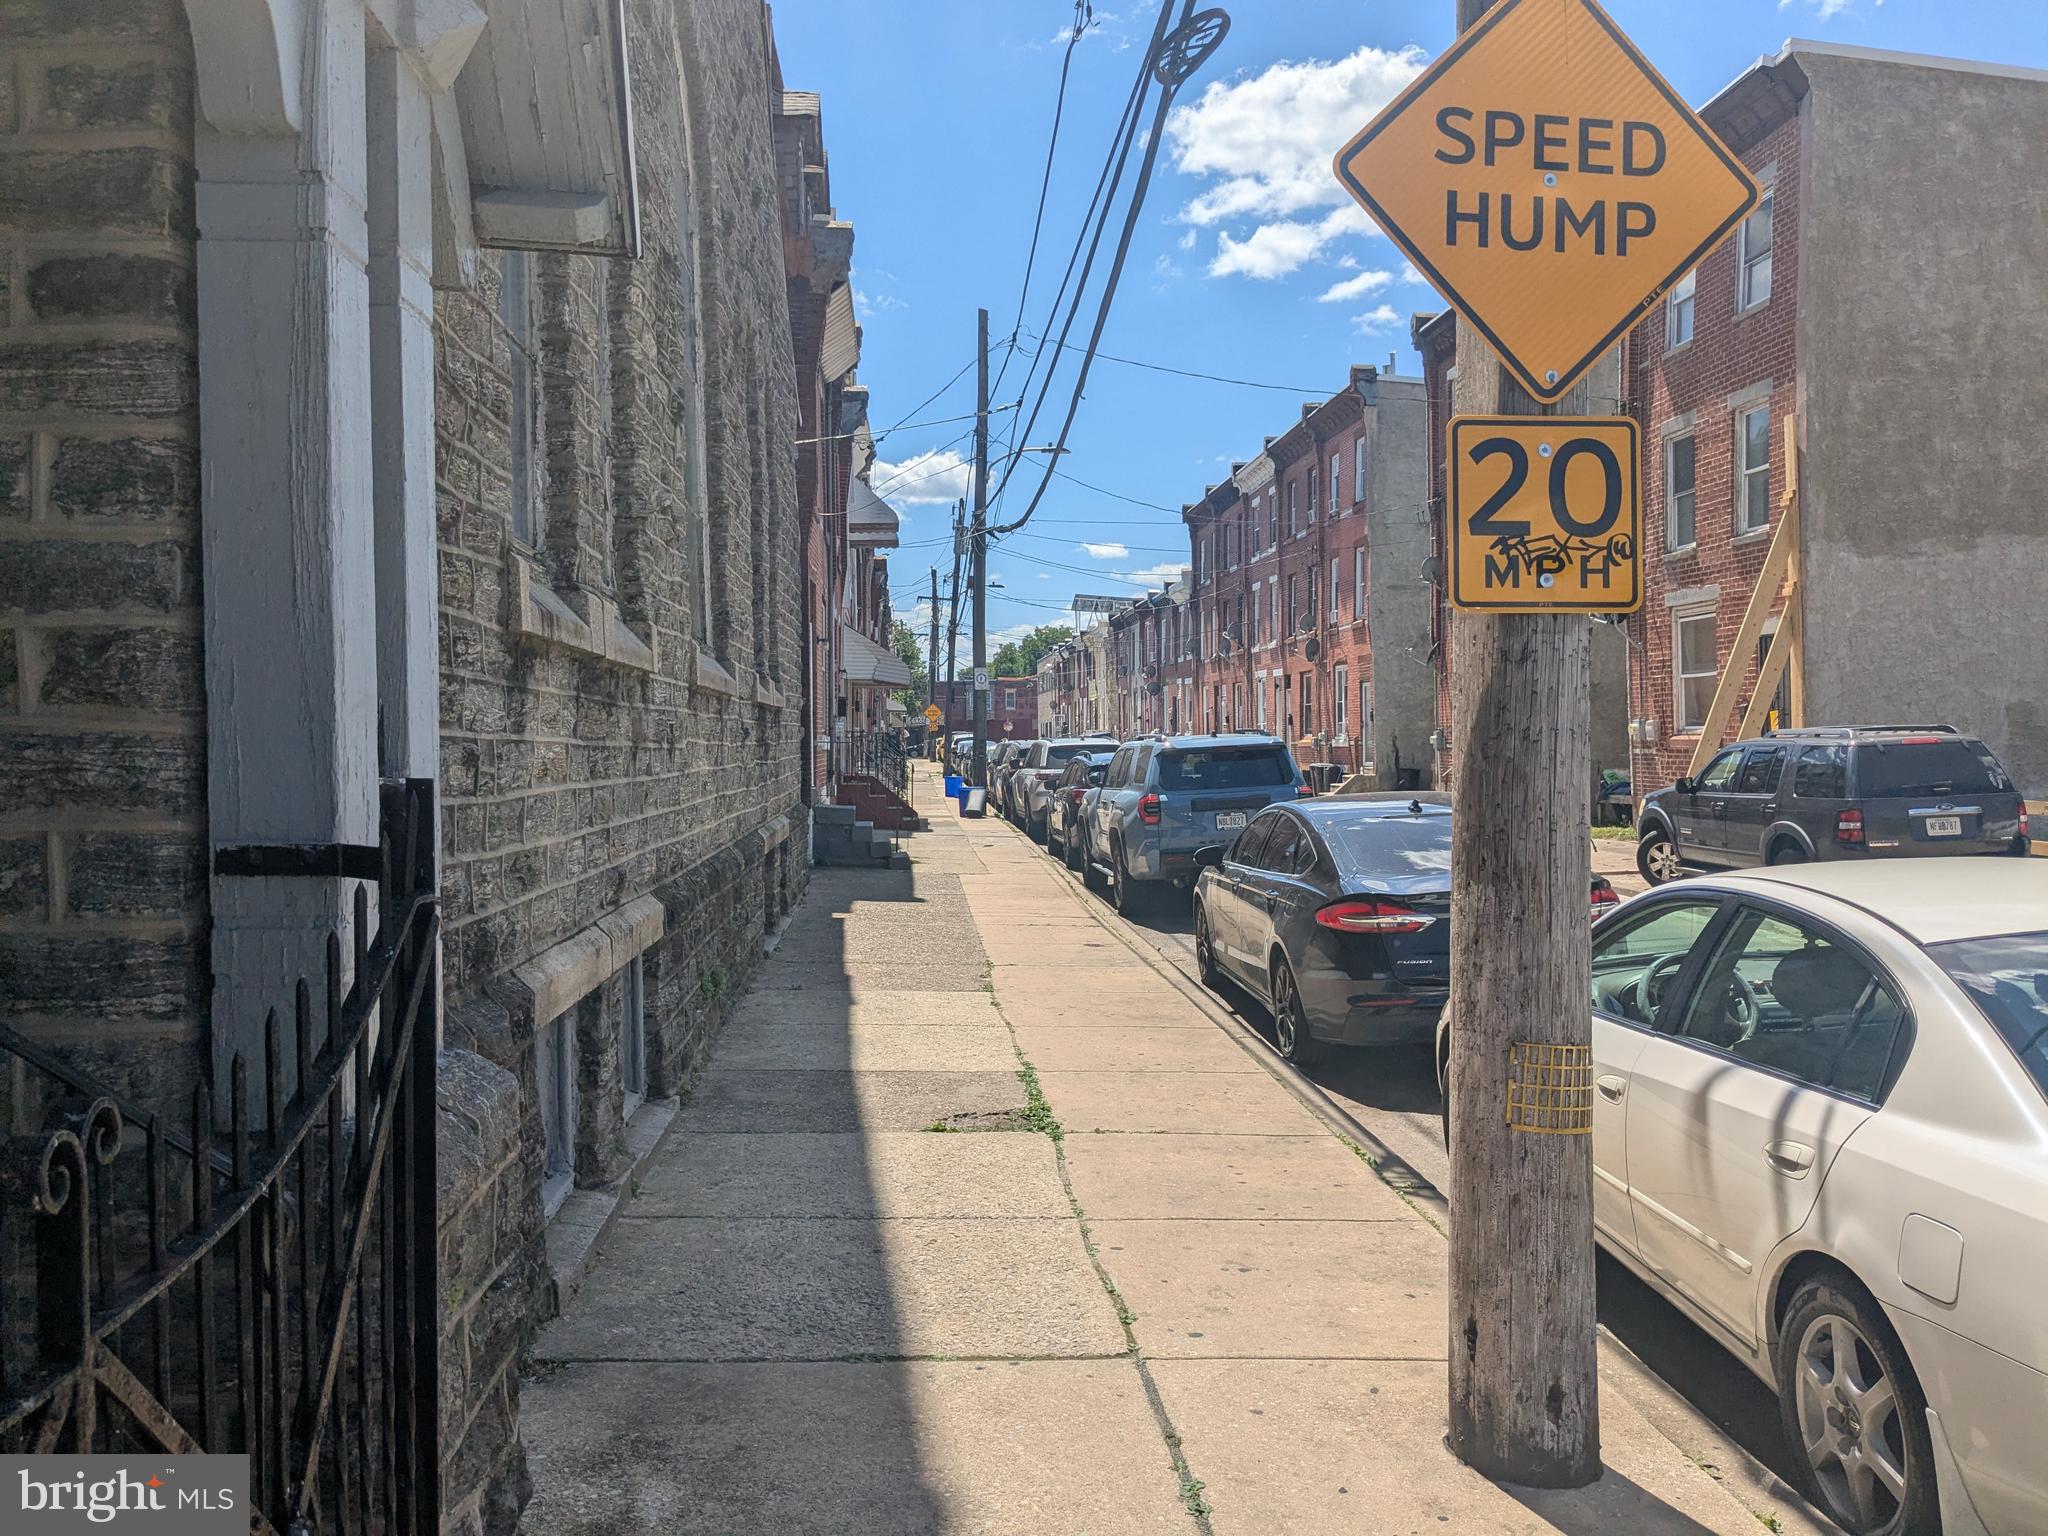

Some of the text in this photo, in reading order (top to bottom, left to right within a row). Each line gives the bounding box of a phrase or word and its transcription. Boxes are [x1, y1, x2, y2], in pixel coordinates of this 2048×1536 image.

[1435, 106, 1667, 177] SPEED
[1445, 190, 1657, 257] HUMP
[1468, 437, 1622, 539] 20
[1485, 554, 1611, 589] MPH
